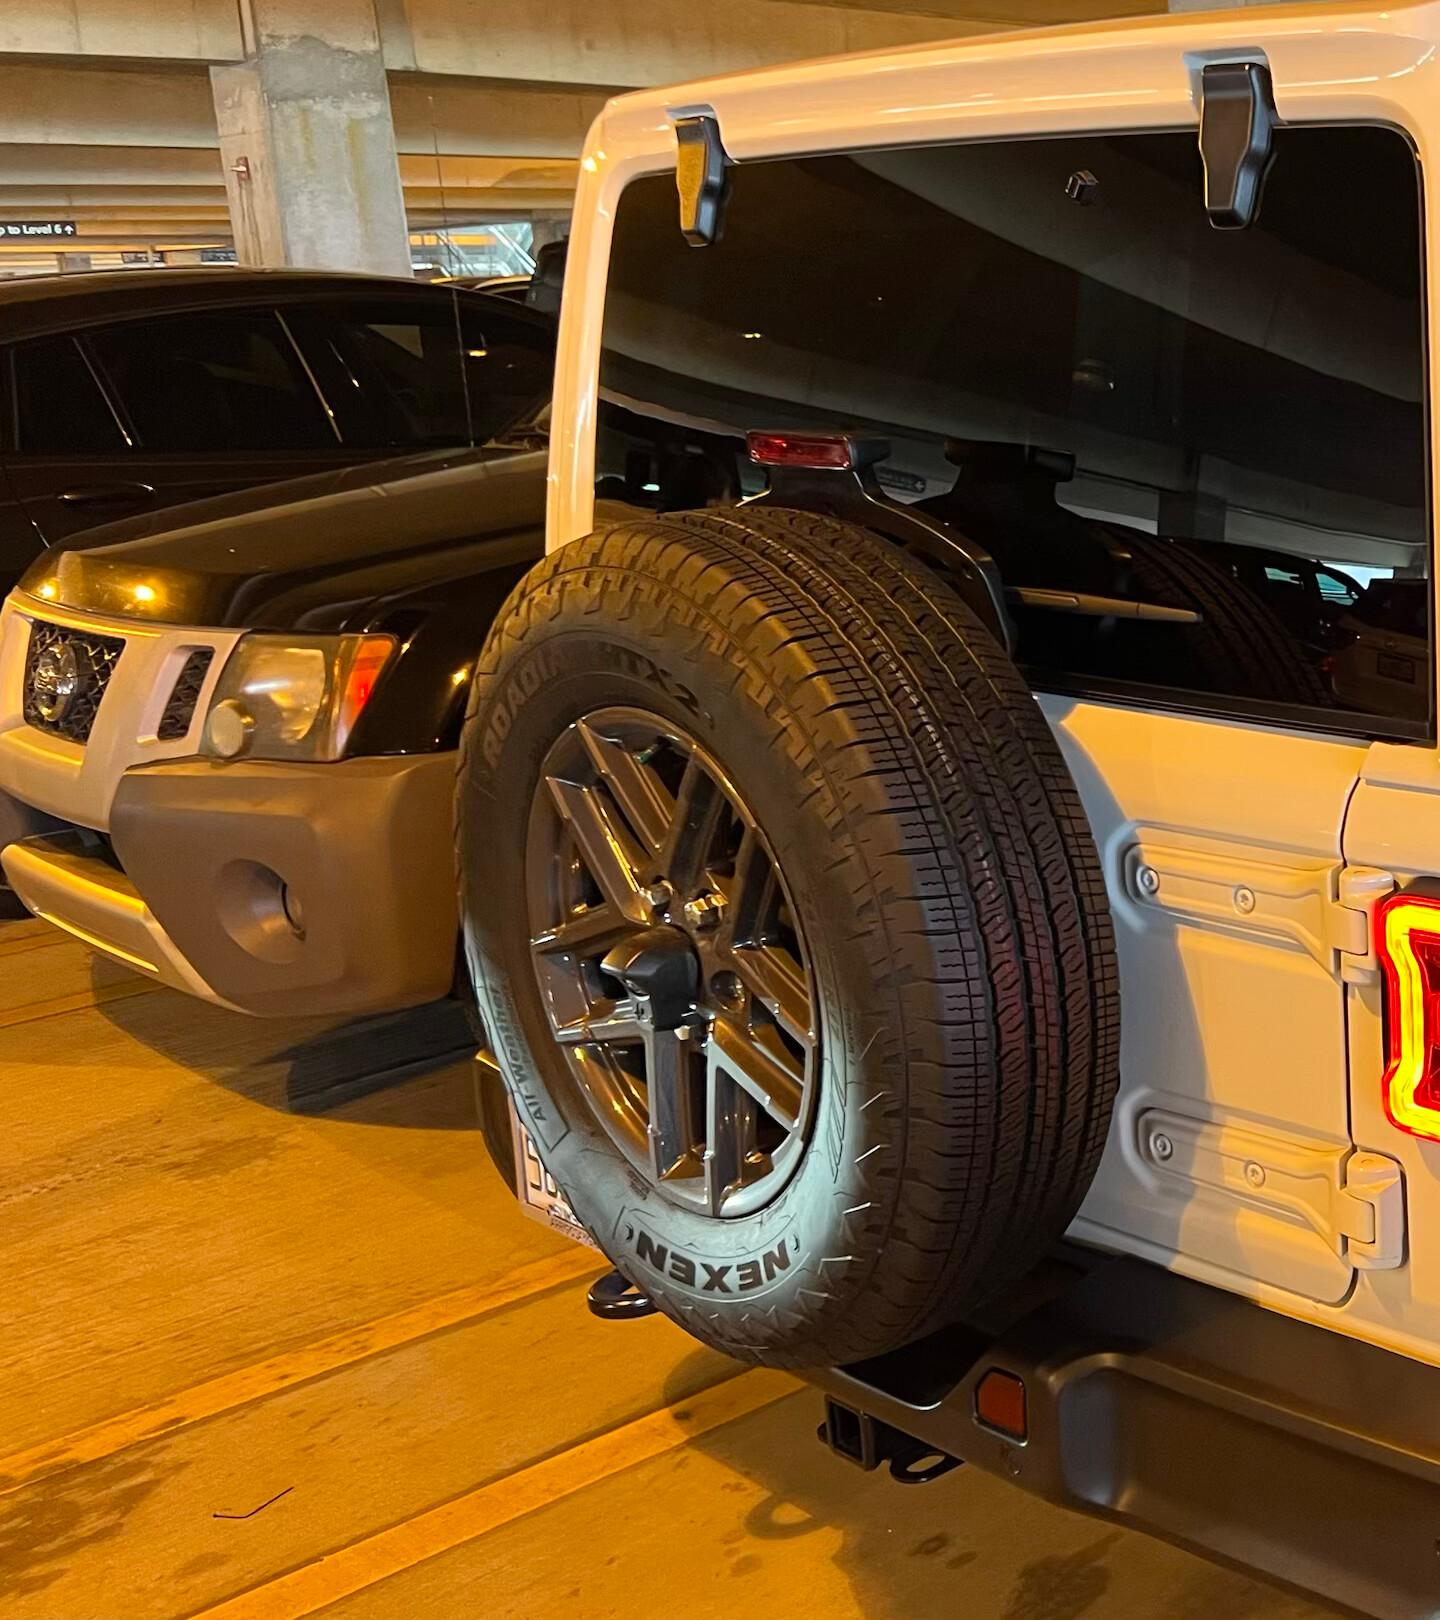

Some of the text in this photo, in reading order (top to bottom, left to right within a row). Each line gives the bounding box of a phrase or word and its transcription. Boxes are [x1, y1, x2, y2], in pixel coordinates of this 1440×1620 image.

[7, 225, 20, 235] to
[22, 223, 52, 235] Level
[54, 223, 62, 235] 6
[636, 1229, 792, 1294] NEXEN
